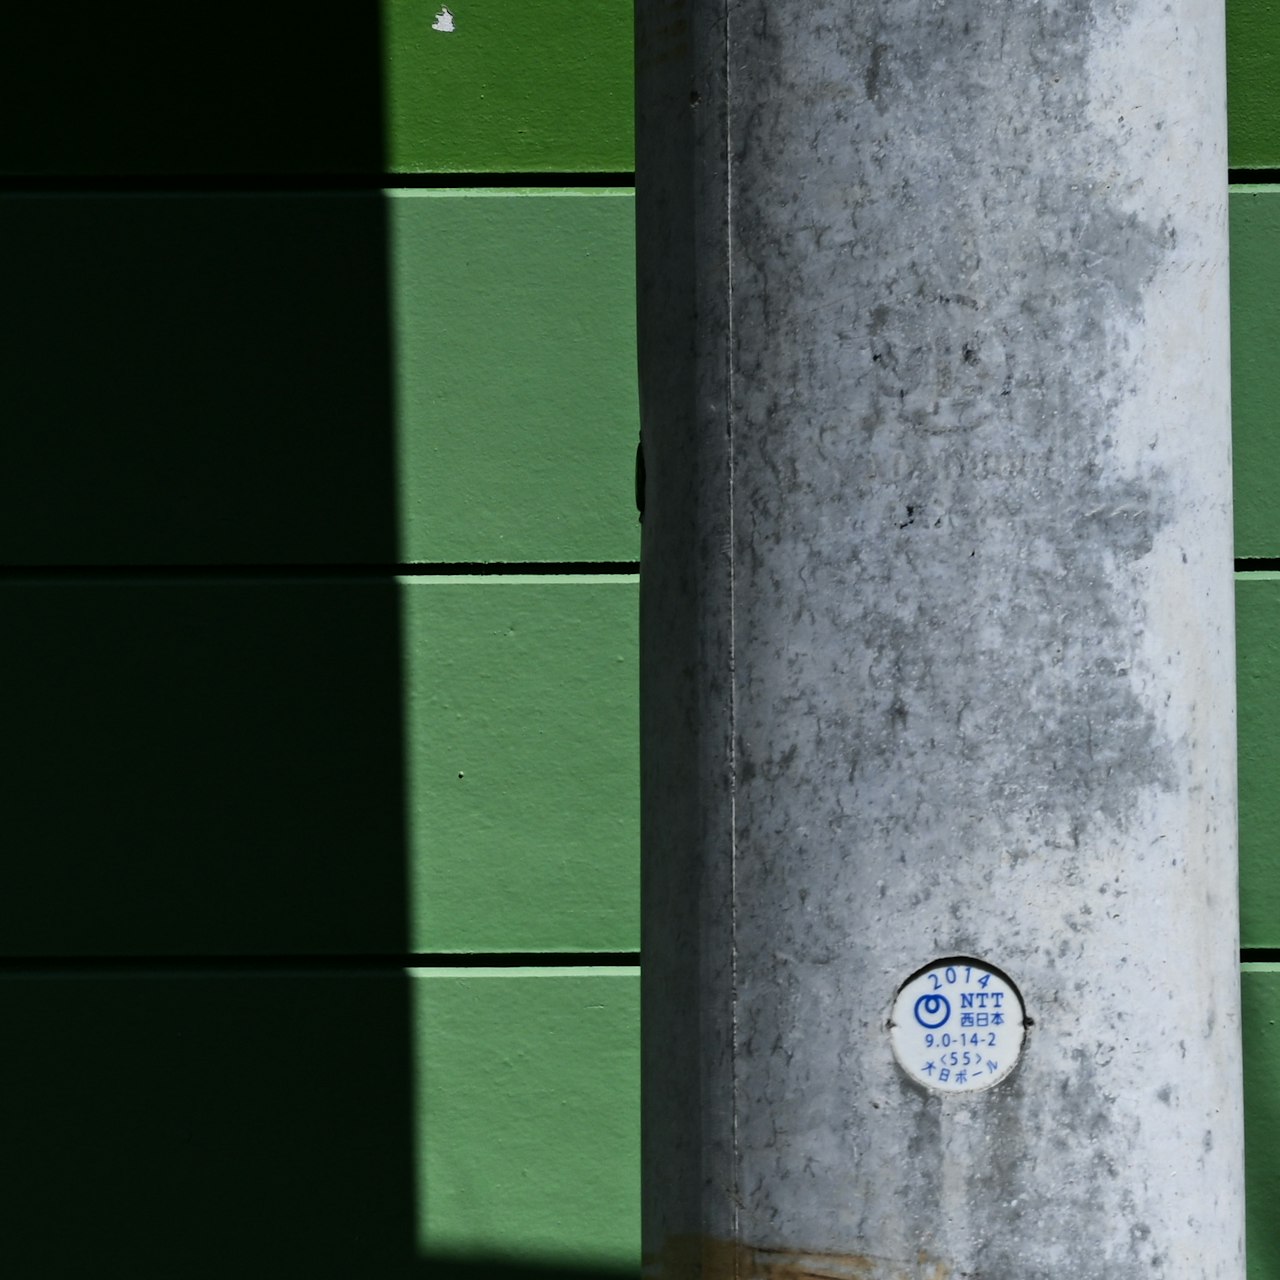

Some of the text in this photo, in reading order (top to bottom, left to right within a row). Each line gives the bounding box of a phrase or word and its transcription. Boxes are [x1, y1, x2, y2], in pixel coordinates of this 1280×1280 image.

[928, 967, 991, 991] 2014
[960, 992, 1004, 1009] NTT
[960, 1012, 1005, 1027] 西日本
[924, 1032, 996, 1048] 9.0-14-2
